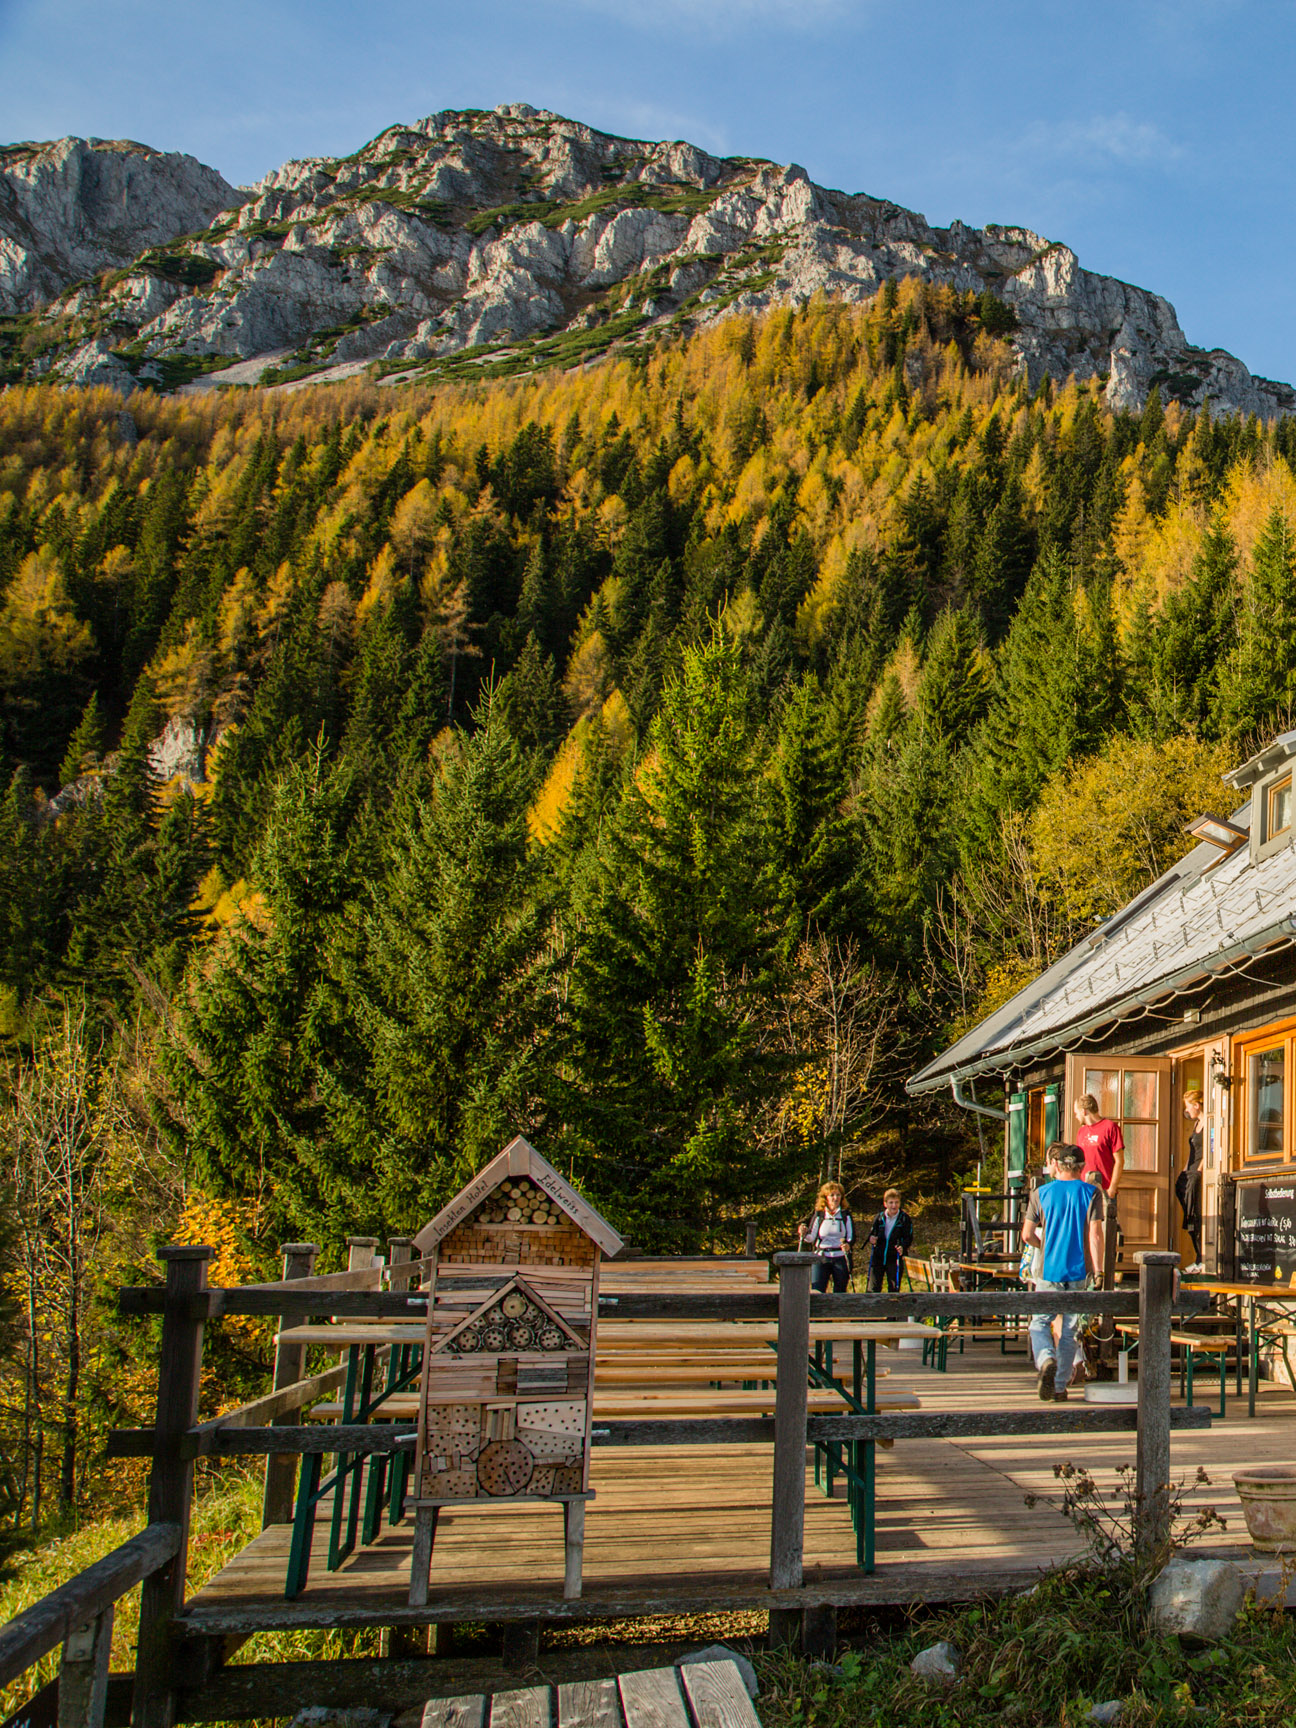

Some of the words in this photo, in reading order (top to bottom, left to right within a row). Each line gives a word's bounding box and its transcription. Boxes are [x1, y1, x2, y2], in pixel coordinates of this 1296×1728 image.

[433, 1205, 467, 1237] Insekten
[466, 1180, 490, 1204] Hotel
[537, 1174, 579, 1215] Edelweiss
